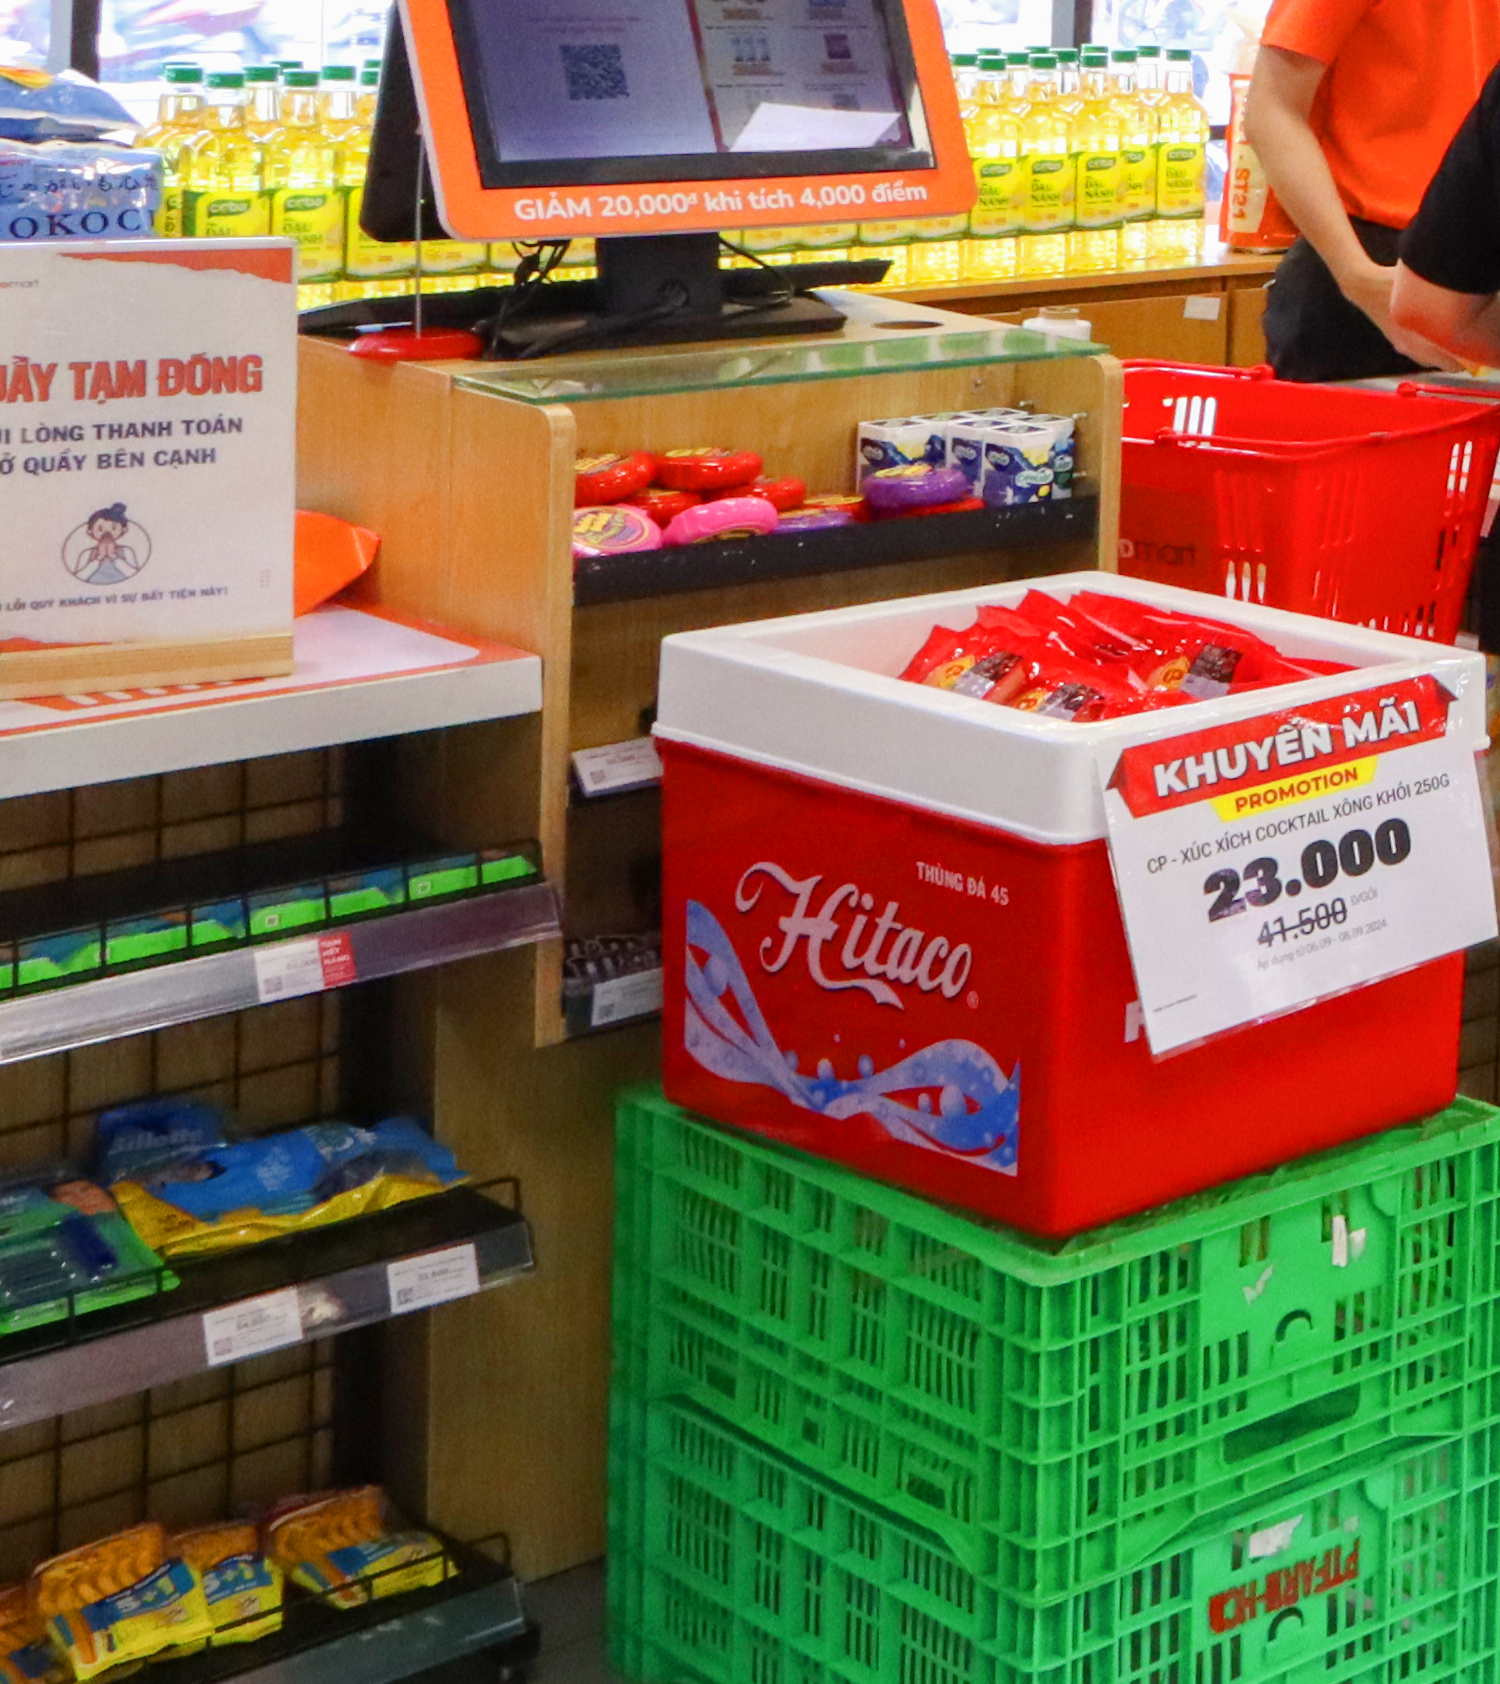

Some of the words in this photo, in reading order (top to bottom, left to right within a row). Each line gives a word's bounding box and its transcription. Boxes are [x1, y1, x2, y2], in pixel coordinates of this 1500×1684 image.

[514, 189, 592, 220] GIẢM
[703, 188, 743, 213] khi
[747, 186, 794, 211] tích
[799, 183, 866, 208] 4,000
[871, 178, 928, 203] điểm
[69, 358, 146, 405] TẠM
[157, 351, 262, 398] ĐÓNG
[21, 418, 84, 443] LÒNG
[93, 422, 172, 440] THANH
[183, 412, 243, 436] TOÁN
[23, 446, 86, 477] QUẦY
[96, 446, 145, 469] BÊN
[153, 448, 217, 470] CẠNH
[1152, 715, 1333, 797] KHUYẾN
[1344, 696, 1420, 750] MÃI
[1234, 767, 1359, 813] PROMOTION
[1146, 855, 1167, 875] CP
[1181, 839, 1213, 866] XÚC
[1216, 830, 1253, 856] XÍCH
[1255, 808, 1330, 843] COCKTAIL
[1333, 794, 1373, 821] XÔNG
[1376, 784, 1412, 810] KHÓI
[1413, 772, 1450, 797] 250G
[915, 858, 965, 890] THÙNG
[966, 872, 987, 900] ĐÁ
[1204, 817, 1412, 923] 23.000
[1257, 897, 1347, 948] 41.500
